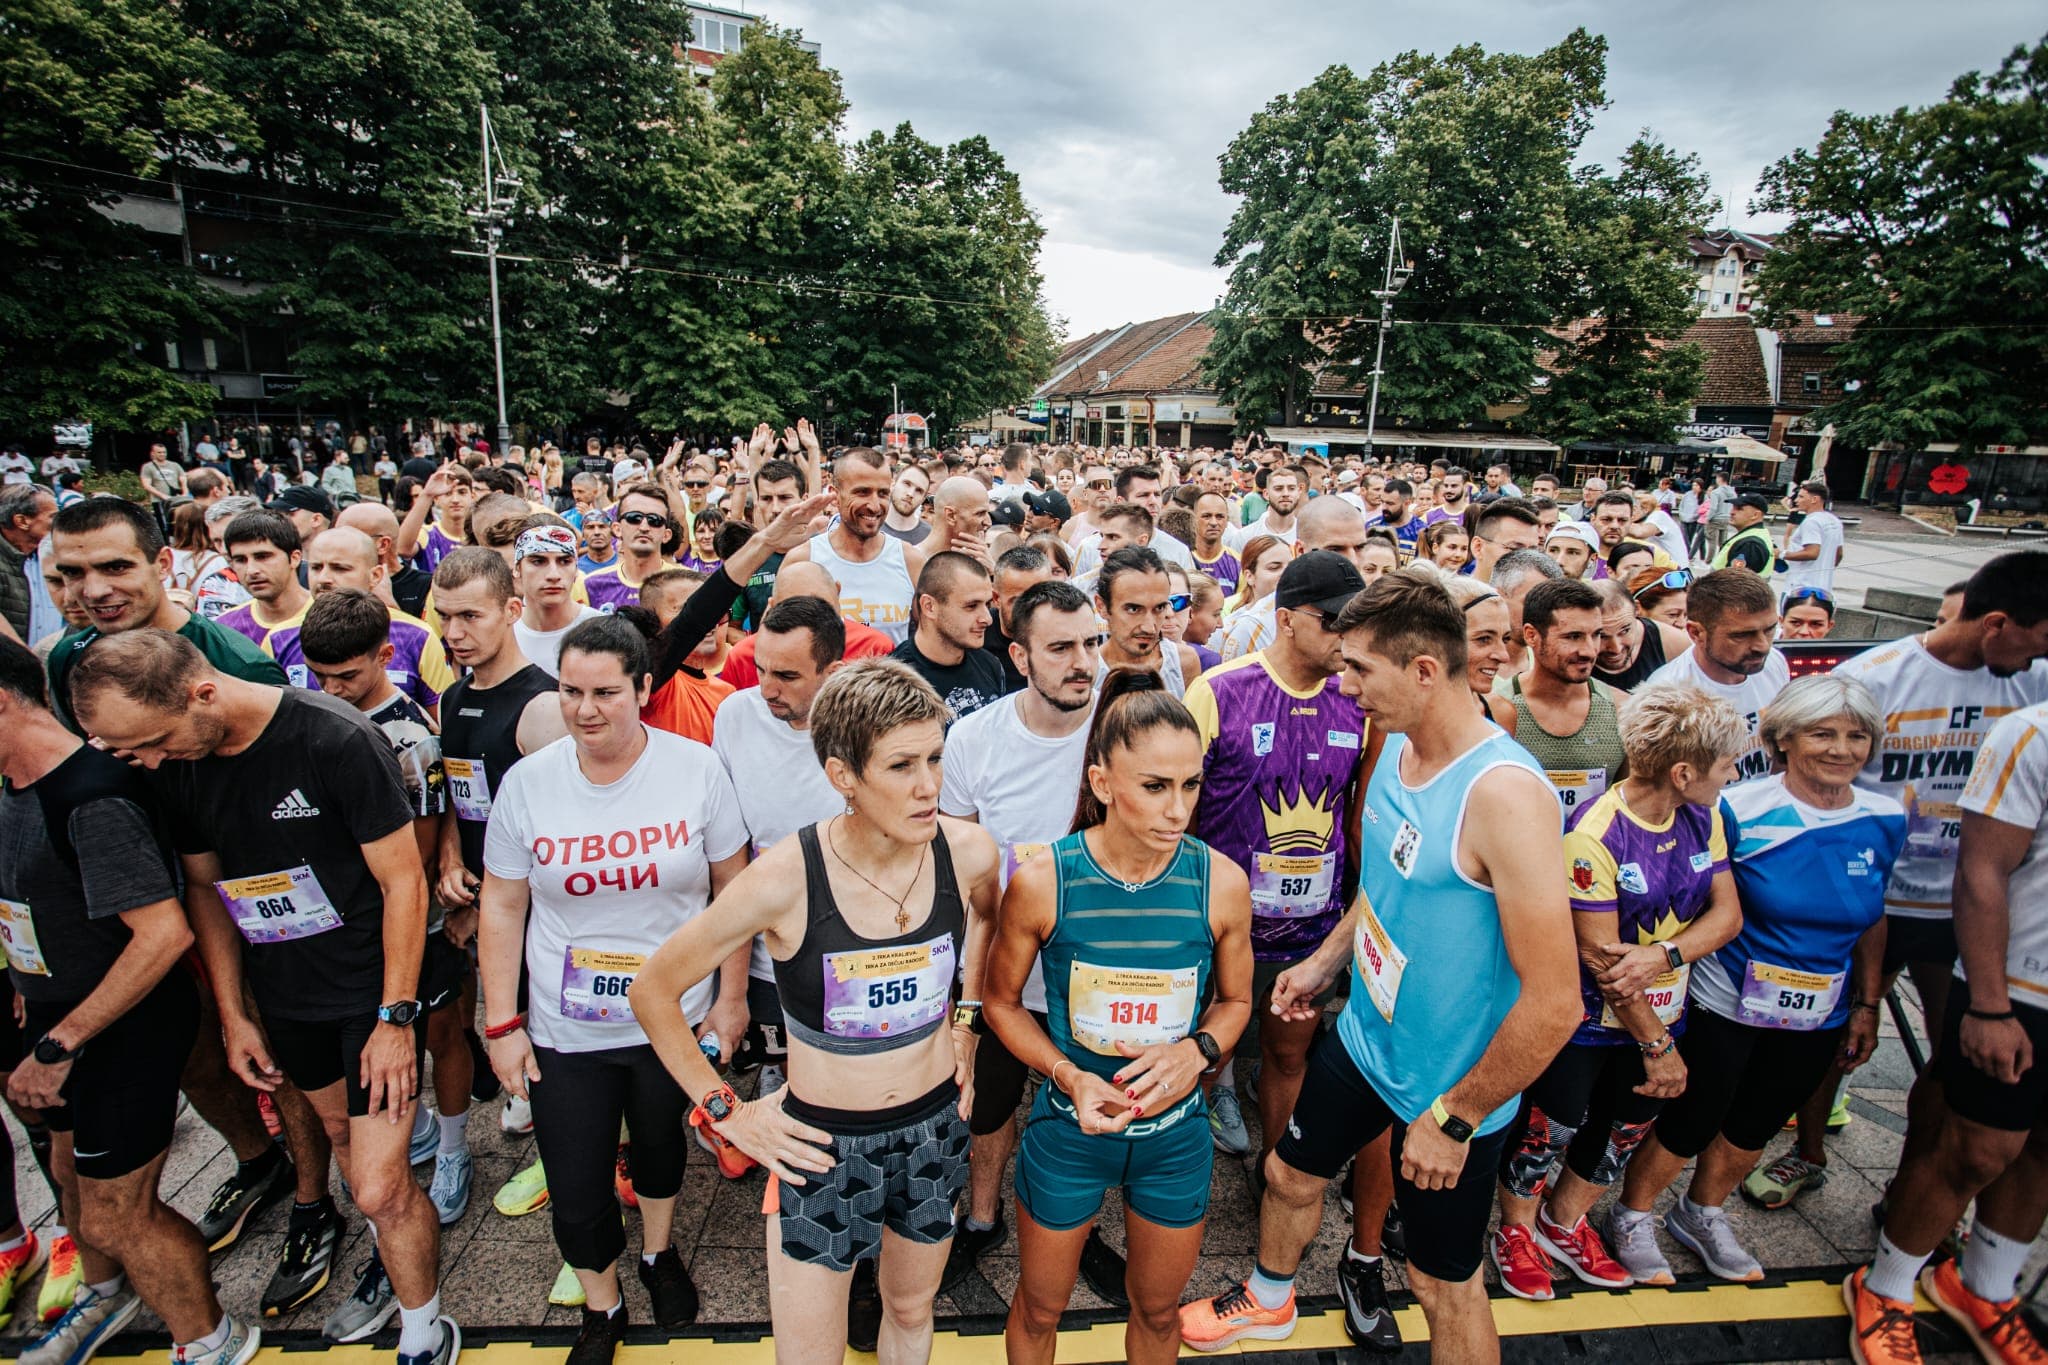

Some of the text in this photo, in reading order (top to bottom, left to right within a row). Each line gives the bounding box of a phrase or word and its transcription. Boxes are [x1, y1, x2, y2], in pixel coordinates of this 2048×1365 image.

[1949, 706, 1982, 729] CF
[453, 780, 471, 799] 723
[1932, 782, 1966, 790] KRALJE
[1559, 789, 1576, 806] 18
[272, 806, 320, 820] adidas
[1940, 821, 1960, 838] 76
[533, 820, 689, 866] ОТВОРИ
[564, 863, 659, 897] ОЧИ
[1280, 878, 1312, 896] 537
[255, 896, 297, 919] 864
[932, 944, 950, 956] 5KM
[1363, 932, 1382, 976] 1088
[868, 976, 918, 1009] 555
[1172, 979, 1195, 989] 10KM
[1646, 991, 1673, 1008] 030
[1778, 990, 1816, 1011] 531
[1109, 1001, 1158, 1025] 1314
